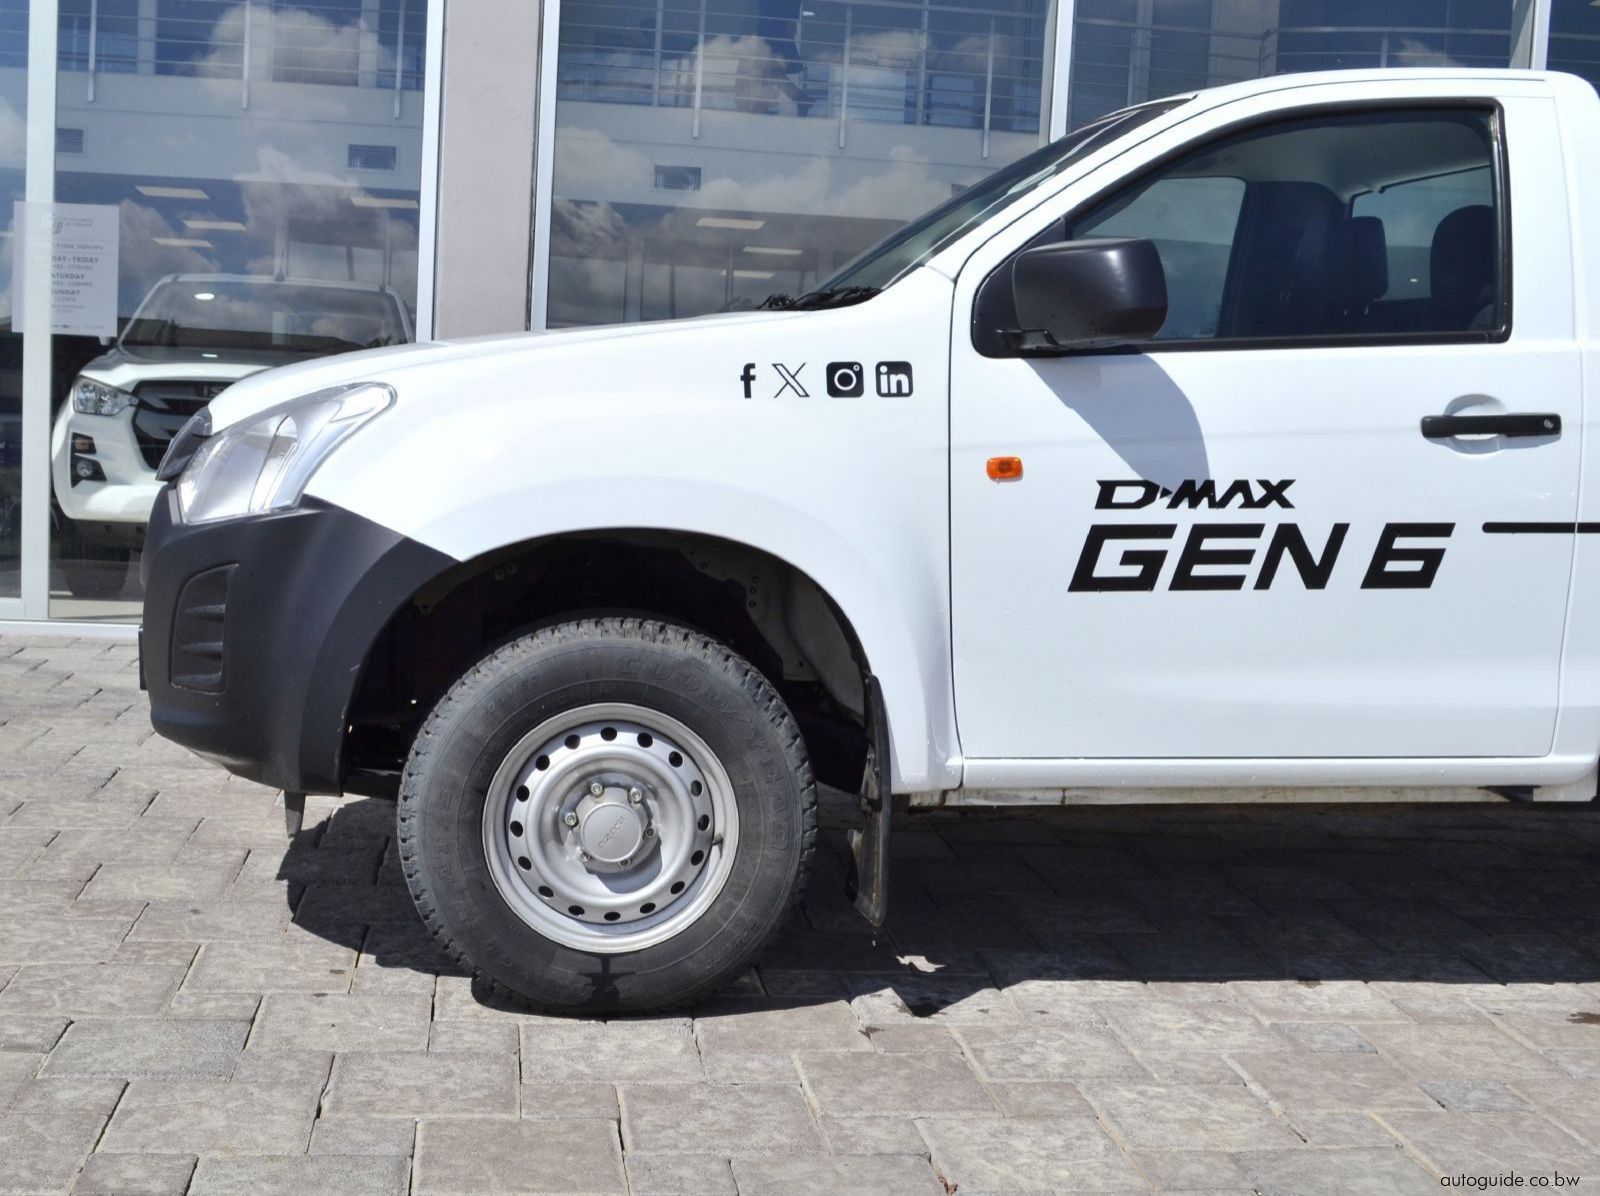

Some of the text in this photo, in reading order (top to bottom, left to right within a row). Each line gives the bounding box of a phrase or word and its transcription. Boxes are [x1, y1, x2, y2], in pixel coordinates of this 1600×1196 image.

[72, 256, 99, 264] FRIDAY
[740, 362, 756, 399] f
[879, 365, 910, 394] in
[1066, 522, 1457, 593] GEN 6
